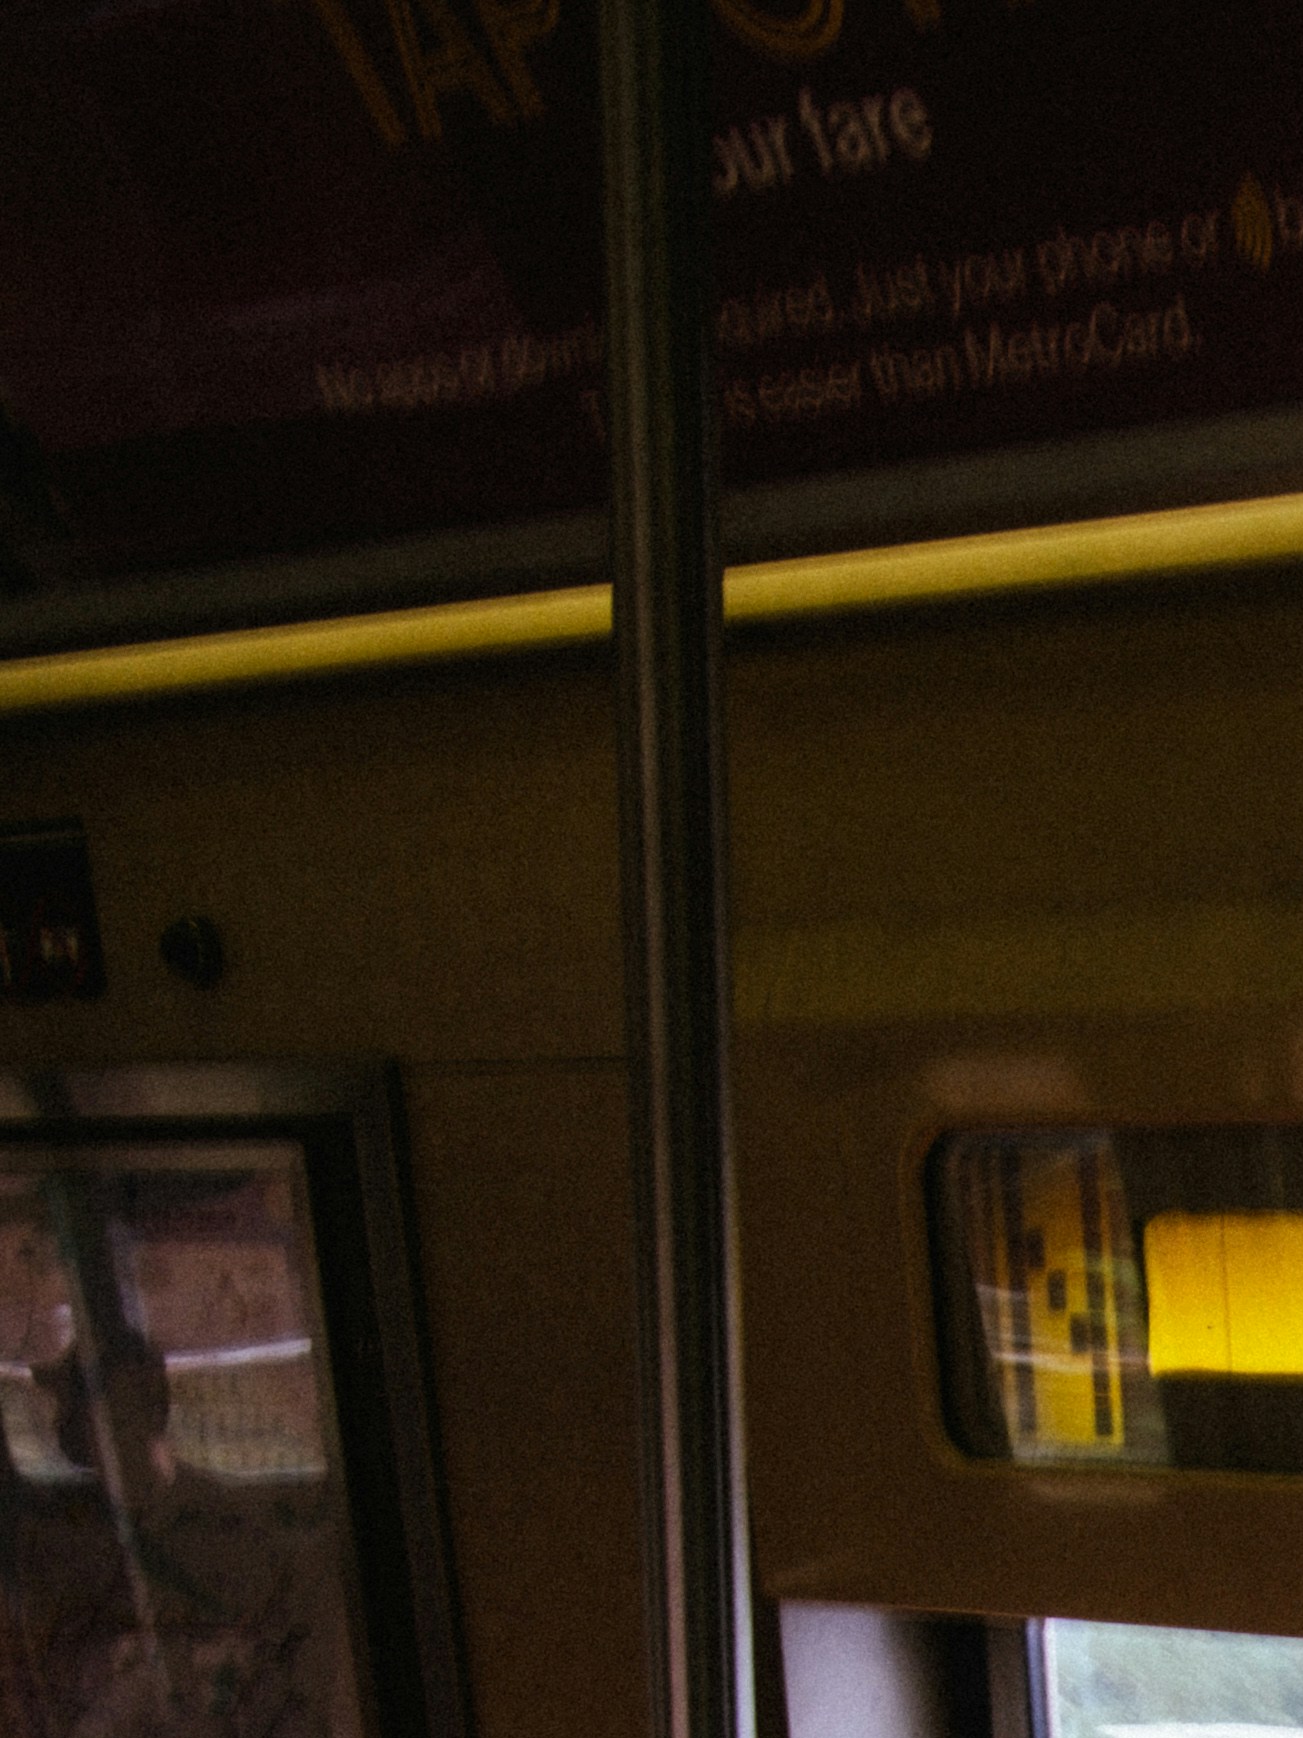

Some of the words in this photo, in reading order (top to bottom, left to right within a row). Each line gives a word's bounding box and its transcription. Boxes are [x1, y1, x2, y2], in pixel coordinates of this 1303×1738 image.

[798, 88, 935, 176] fare
[1035, 222, 1174, 298] phone
[868, 345, 962, 400] than
